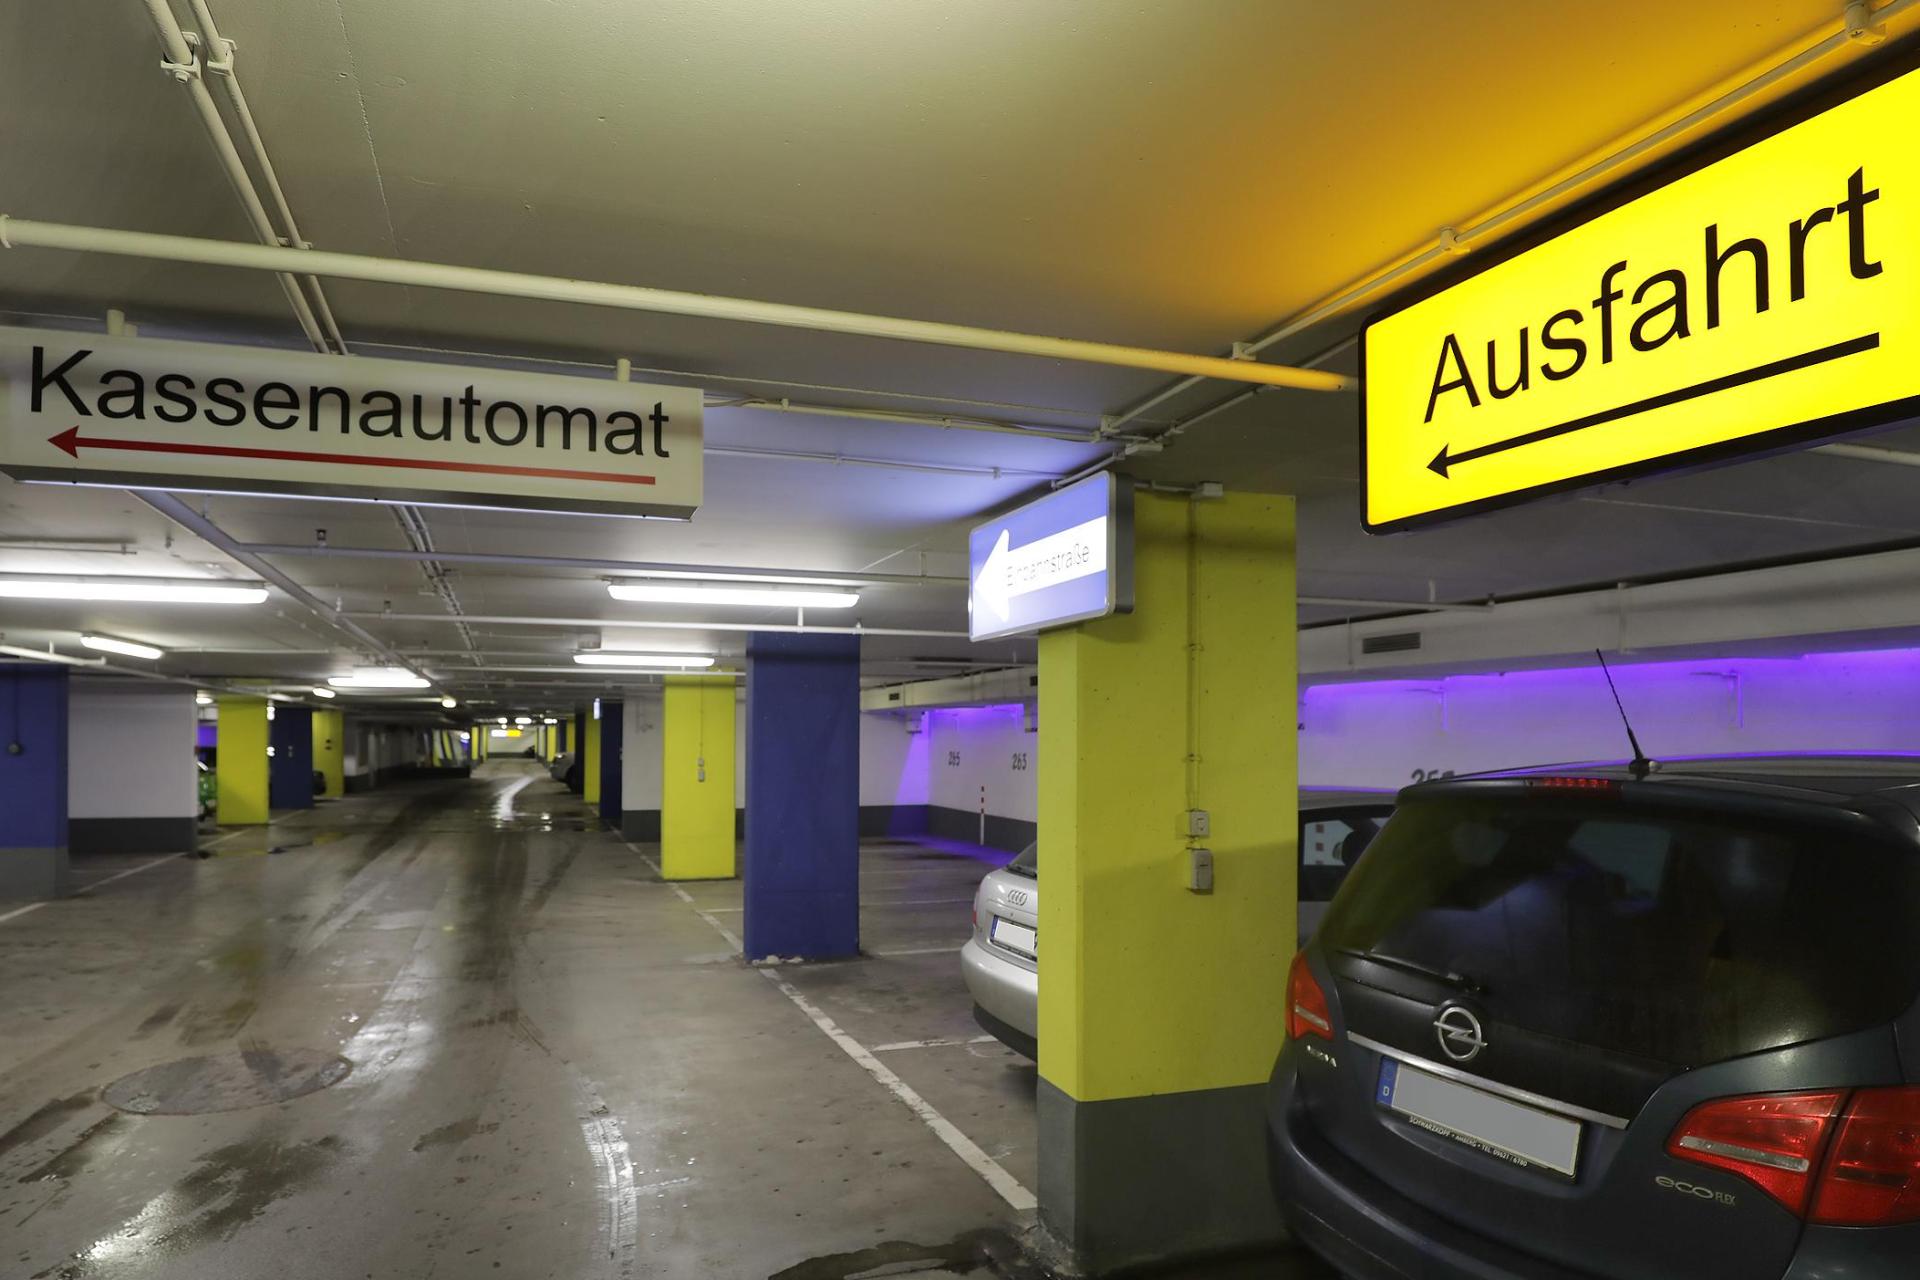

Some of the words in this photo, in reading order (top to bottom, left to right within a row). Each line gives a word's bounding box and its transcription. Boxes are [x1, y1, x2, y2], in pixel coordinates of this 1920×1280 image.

[1423, 165, 1884, 424] Ausfahrt
[30, 346, 670, 458] Kassenautomat
[1012, 752, 1027, 770] 263
